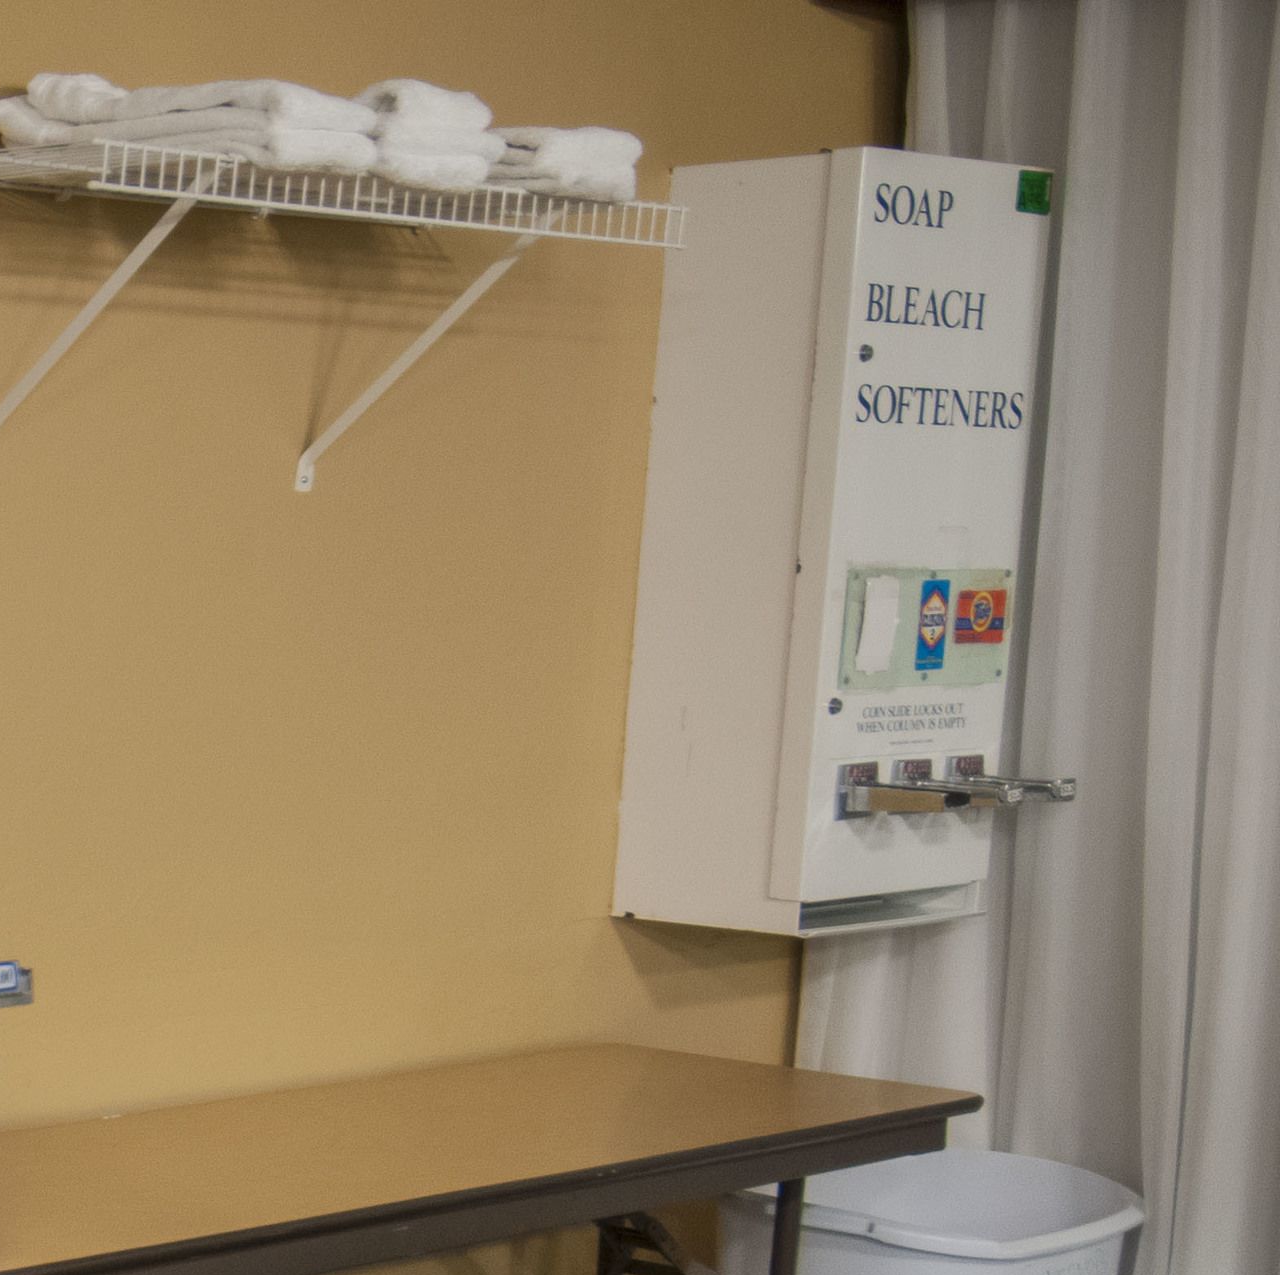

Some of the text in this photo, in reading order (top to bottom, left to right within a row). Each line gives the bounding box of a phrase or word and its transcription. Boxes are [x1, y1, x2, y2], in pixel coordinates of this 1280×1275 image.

[873, 183, 954, 228] SOAP
[865, 283, 986, 330] BLEACH
[855, 384, 1023, 430] SOFTENERS
[856, 721, 885, 733] WHEN
[913, 703, 944, 716] LOCKS
[945, 702, 964, 715] OUT
